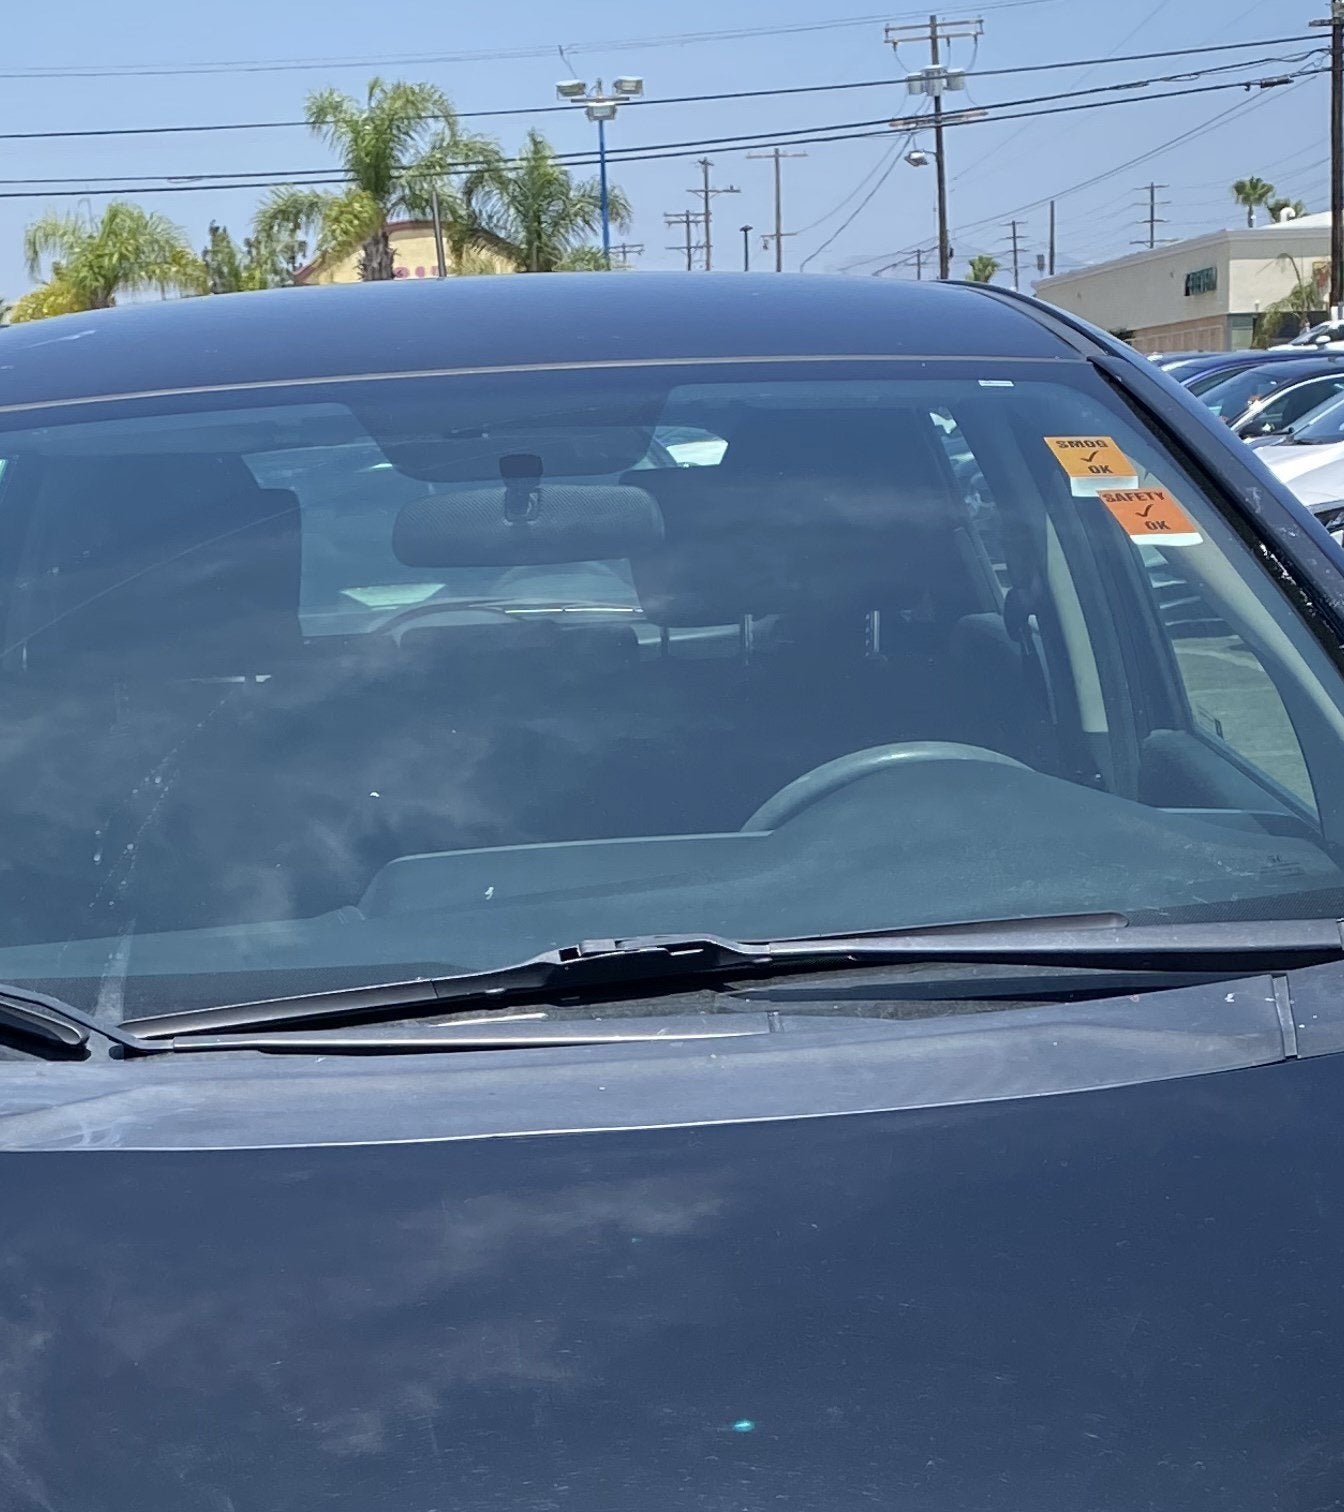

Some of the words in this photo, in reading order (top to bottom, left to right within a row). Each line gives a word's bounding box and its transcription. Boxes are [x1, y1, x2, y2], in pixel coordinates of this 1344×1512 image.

[1055, 439, 1109, 449] SMOG
[1087, 464, 1114, 475] OK
[1102, 491, 1166, 503] SAFETY
[1144, 520, 1170, 531] OK
